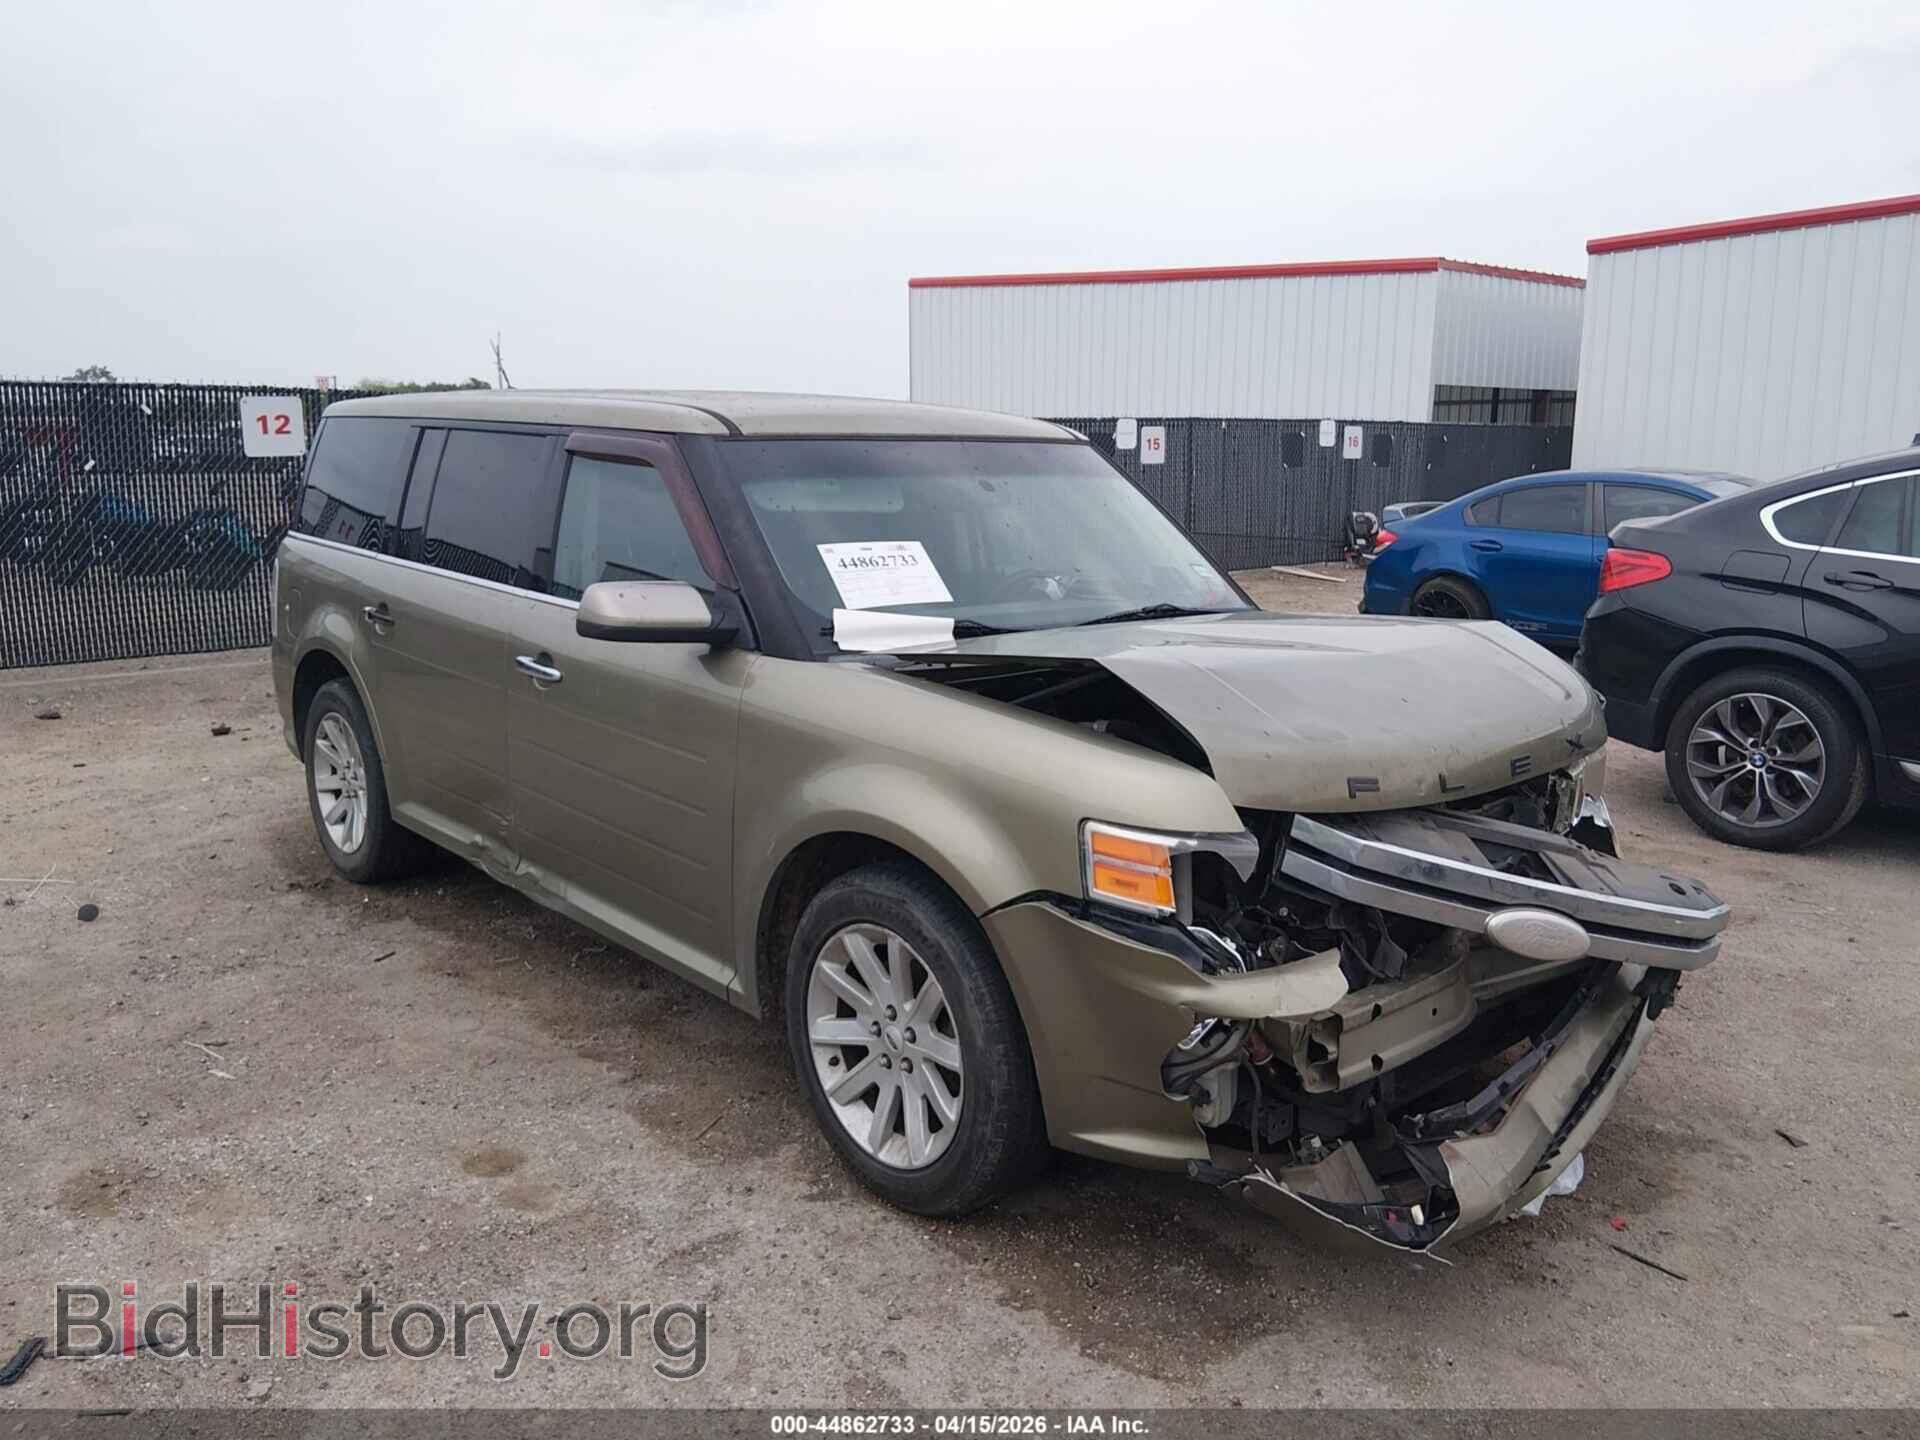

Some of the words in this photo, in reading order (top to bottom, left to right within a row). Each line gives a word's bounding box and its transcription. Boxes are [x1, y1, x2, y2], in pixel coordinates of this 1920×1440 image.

[256, 414, 291, 435] 12
[1146, 438, 1160, 450] 15
[1348, 436, 1359, 448] 16
[838, 554, 918, 569] 44862733
[1347, 733, 1584, 799] FLEX
